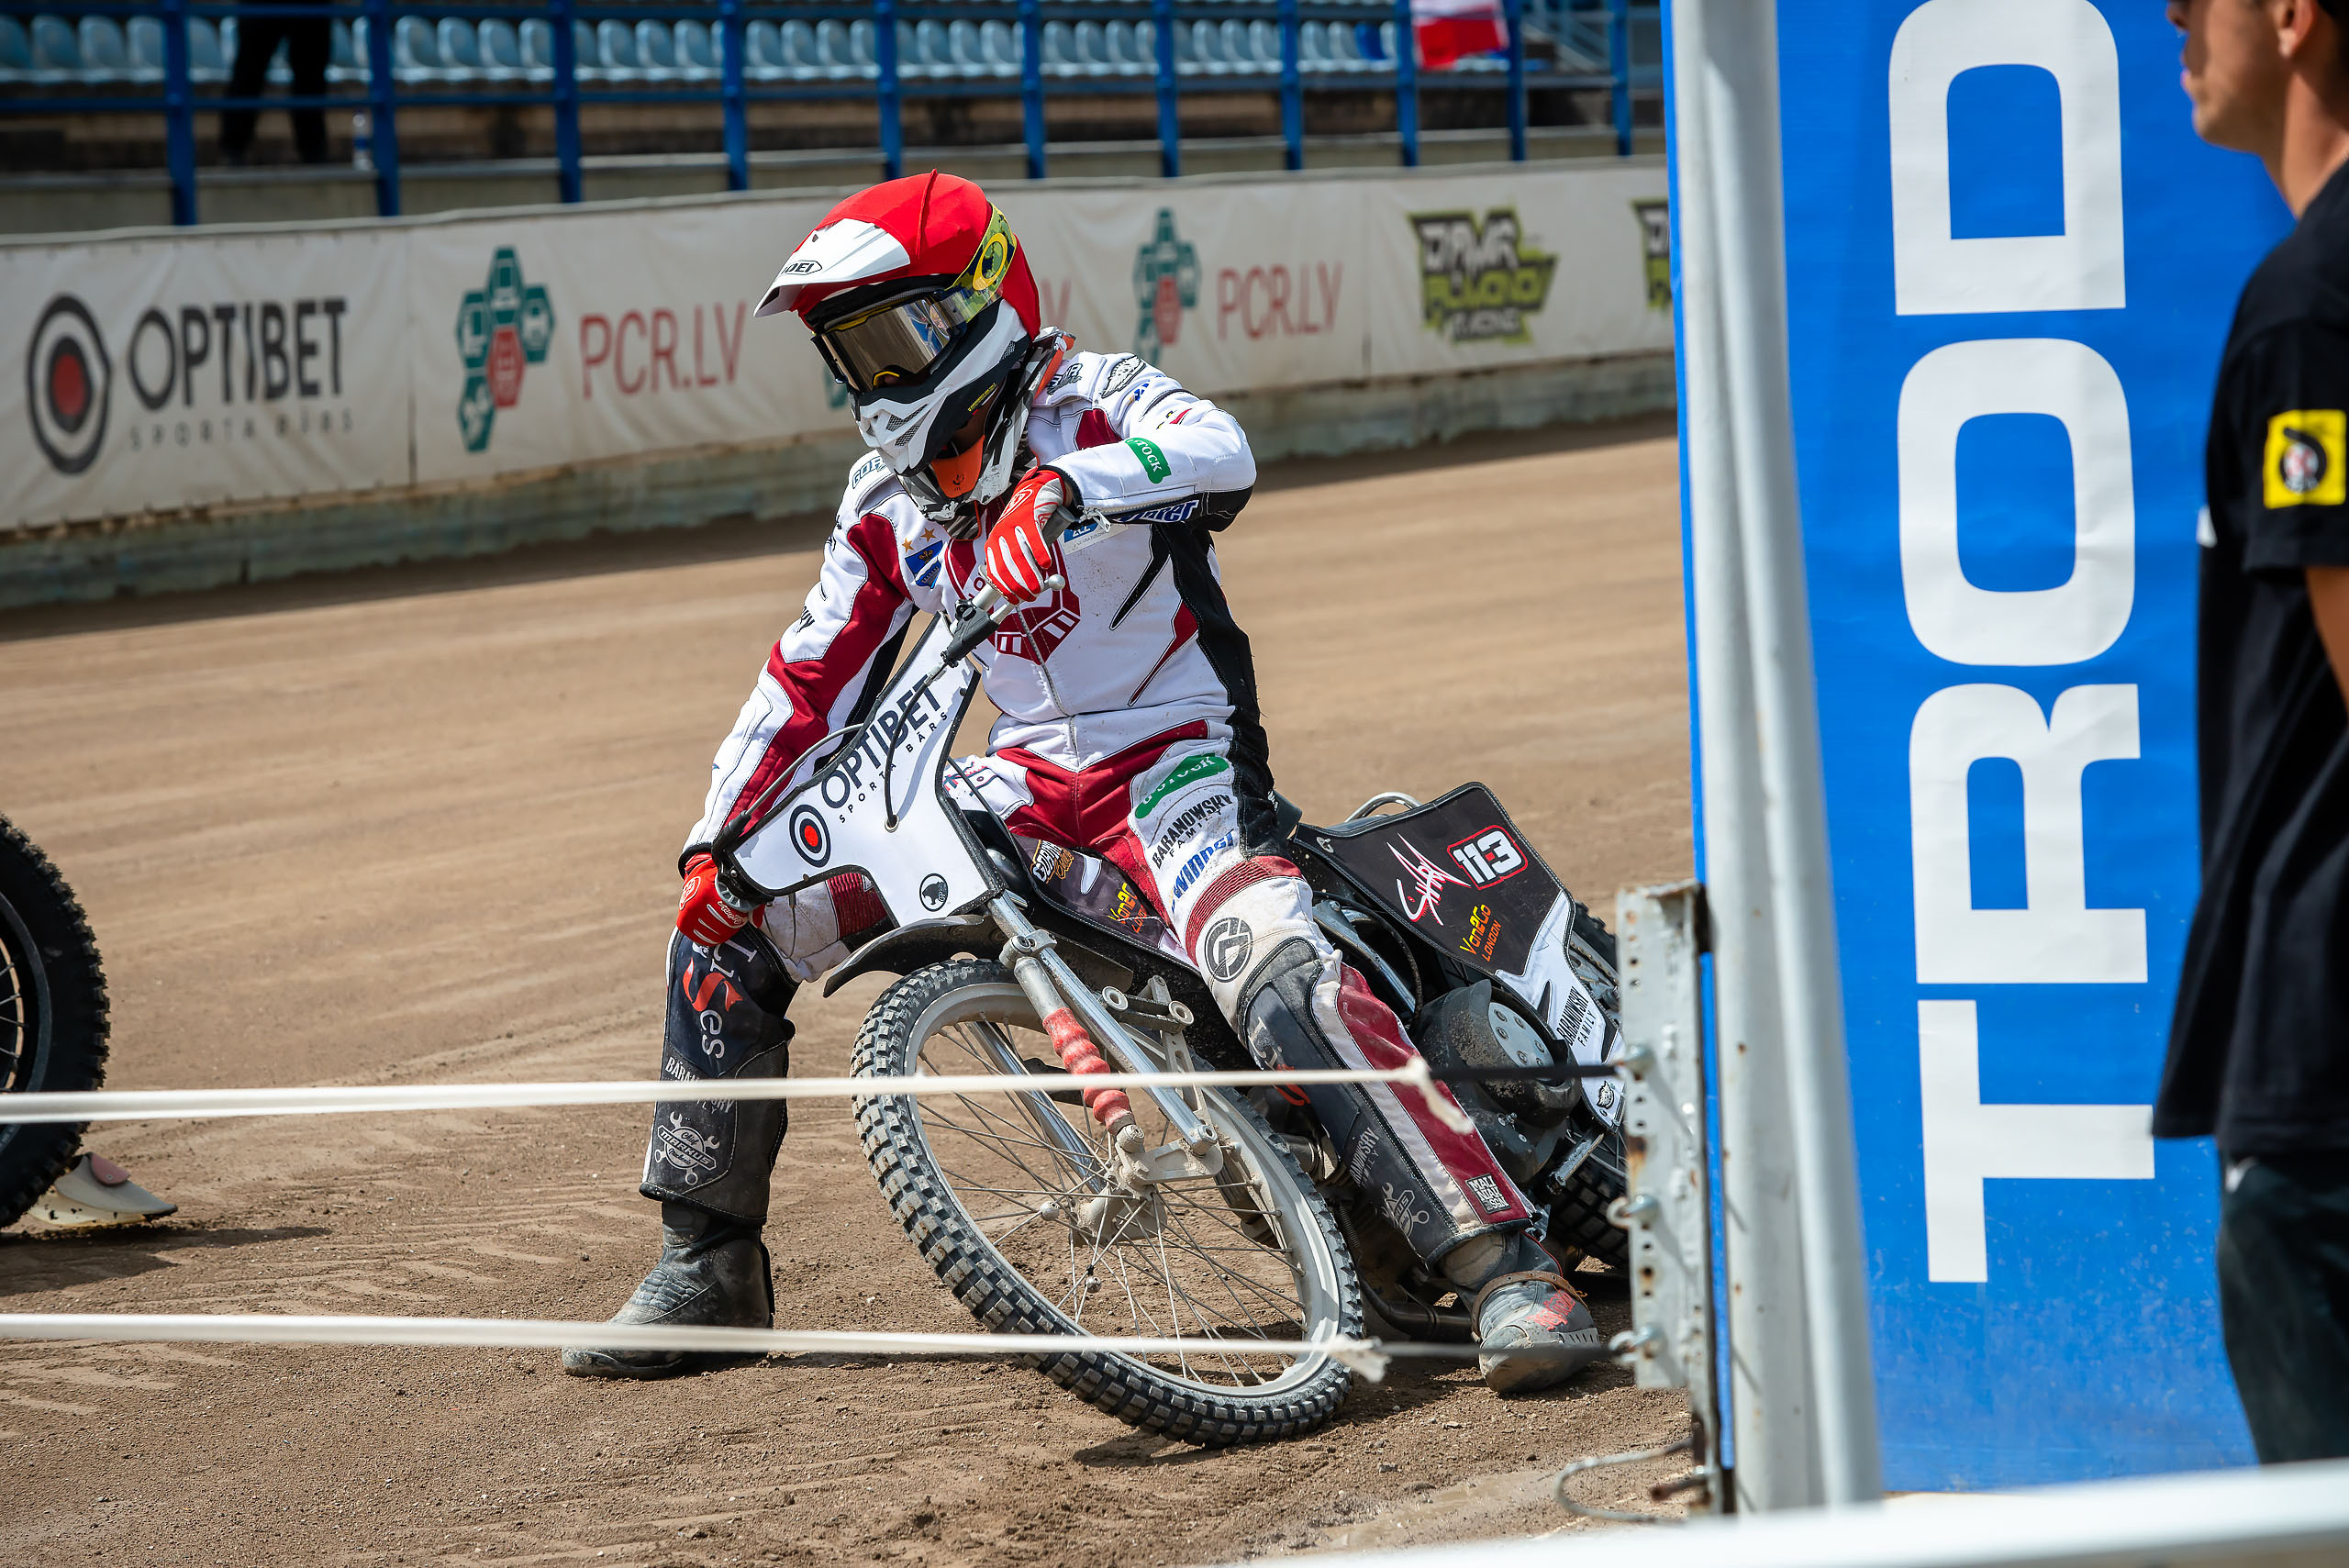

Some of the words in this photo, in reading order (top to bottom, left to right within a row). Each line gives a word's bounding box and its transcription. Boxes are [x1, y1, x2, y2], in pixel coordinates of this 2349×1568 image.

[128, 299, 346, 409] OPTIBET
[580, 300, 747, 399] PCR.LV
[130, 419, 255, 450] SPORTA
[821, 674, 941, 808] OPTIBET
[839, 763, 896, 823] SPORTA
[1152, 794, 1233, 869] BARANOWSKY
[1453, 830, 1522, 884] 113
[1460, 904, 1491, 954] Van2Go
[1482, 919, 1502, 962] LONDON
[1556, 985, 1588, 1046] BARANOWSKY
[1577, 1010, 1596, 1047] FAMILY
[661, 1130, 710, 1166] MARKUS
